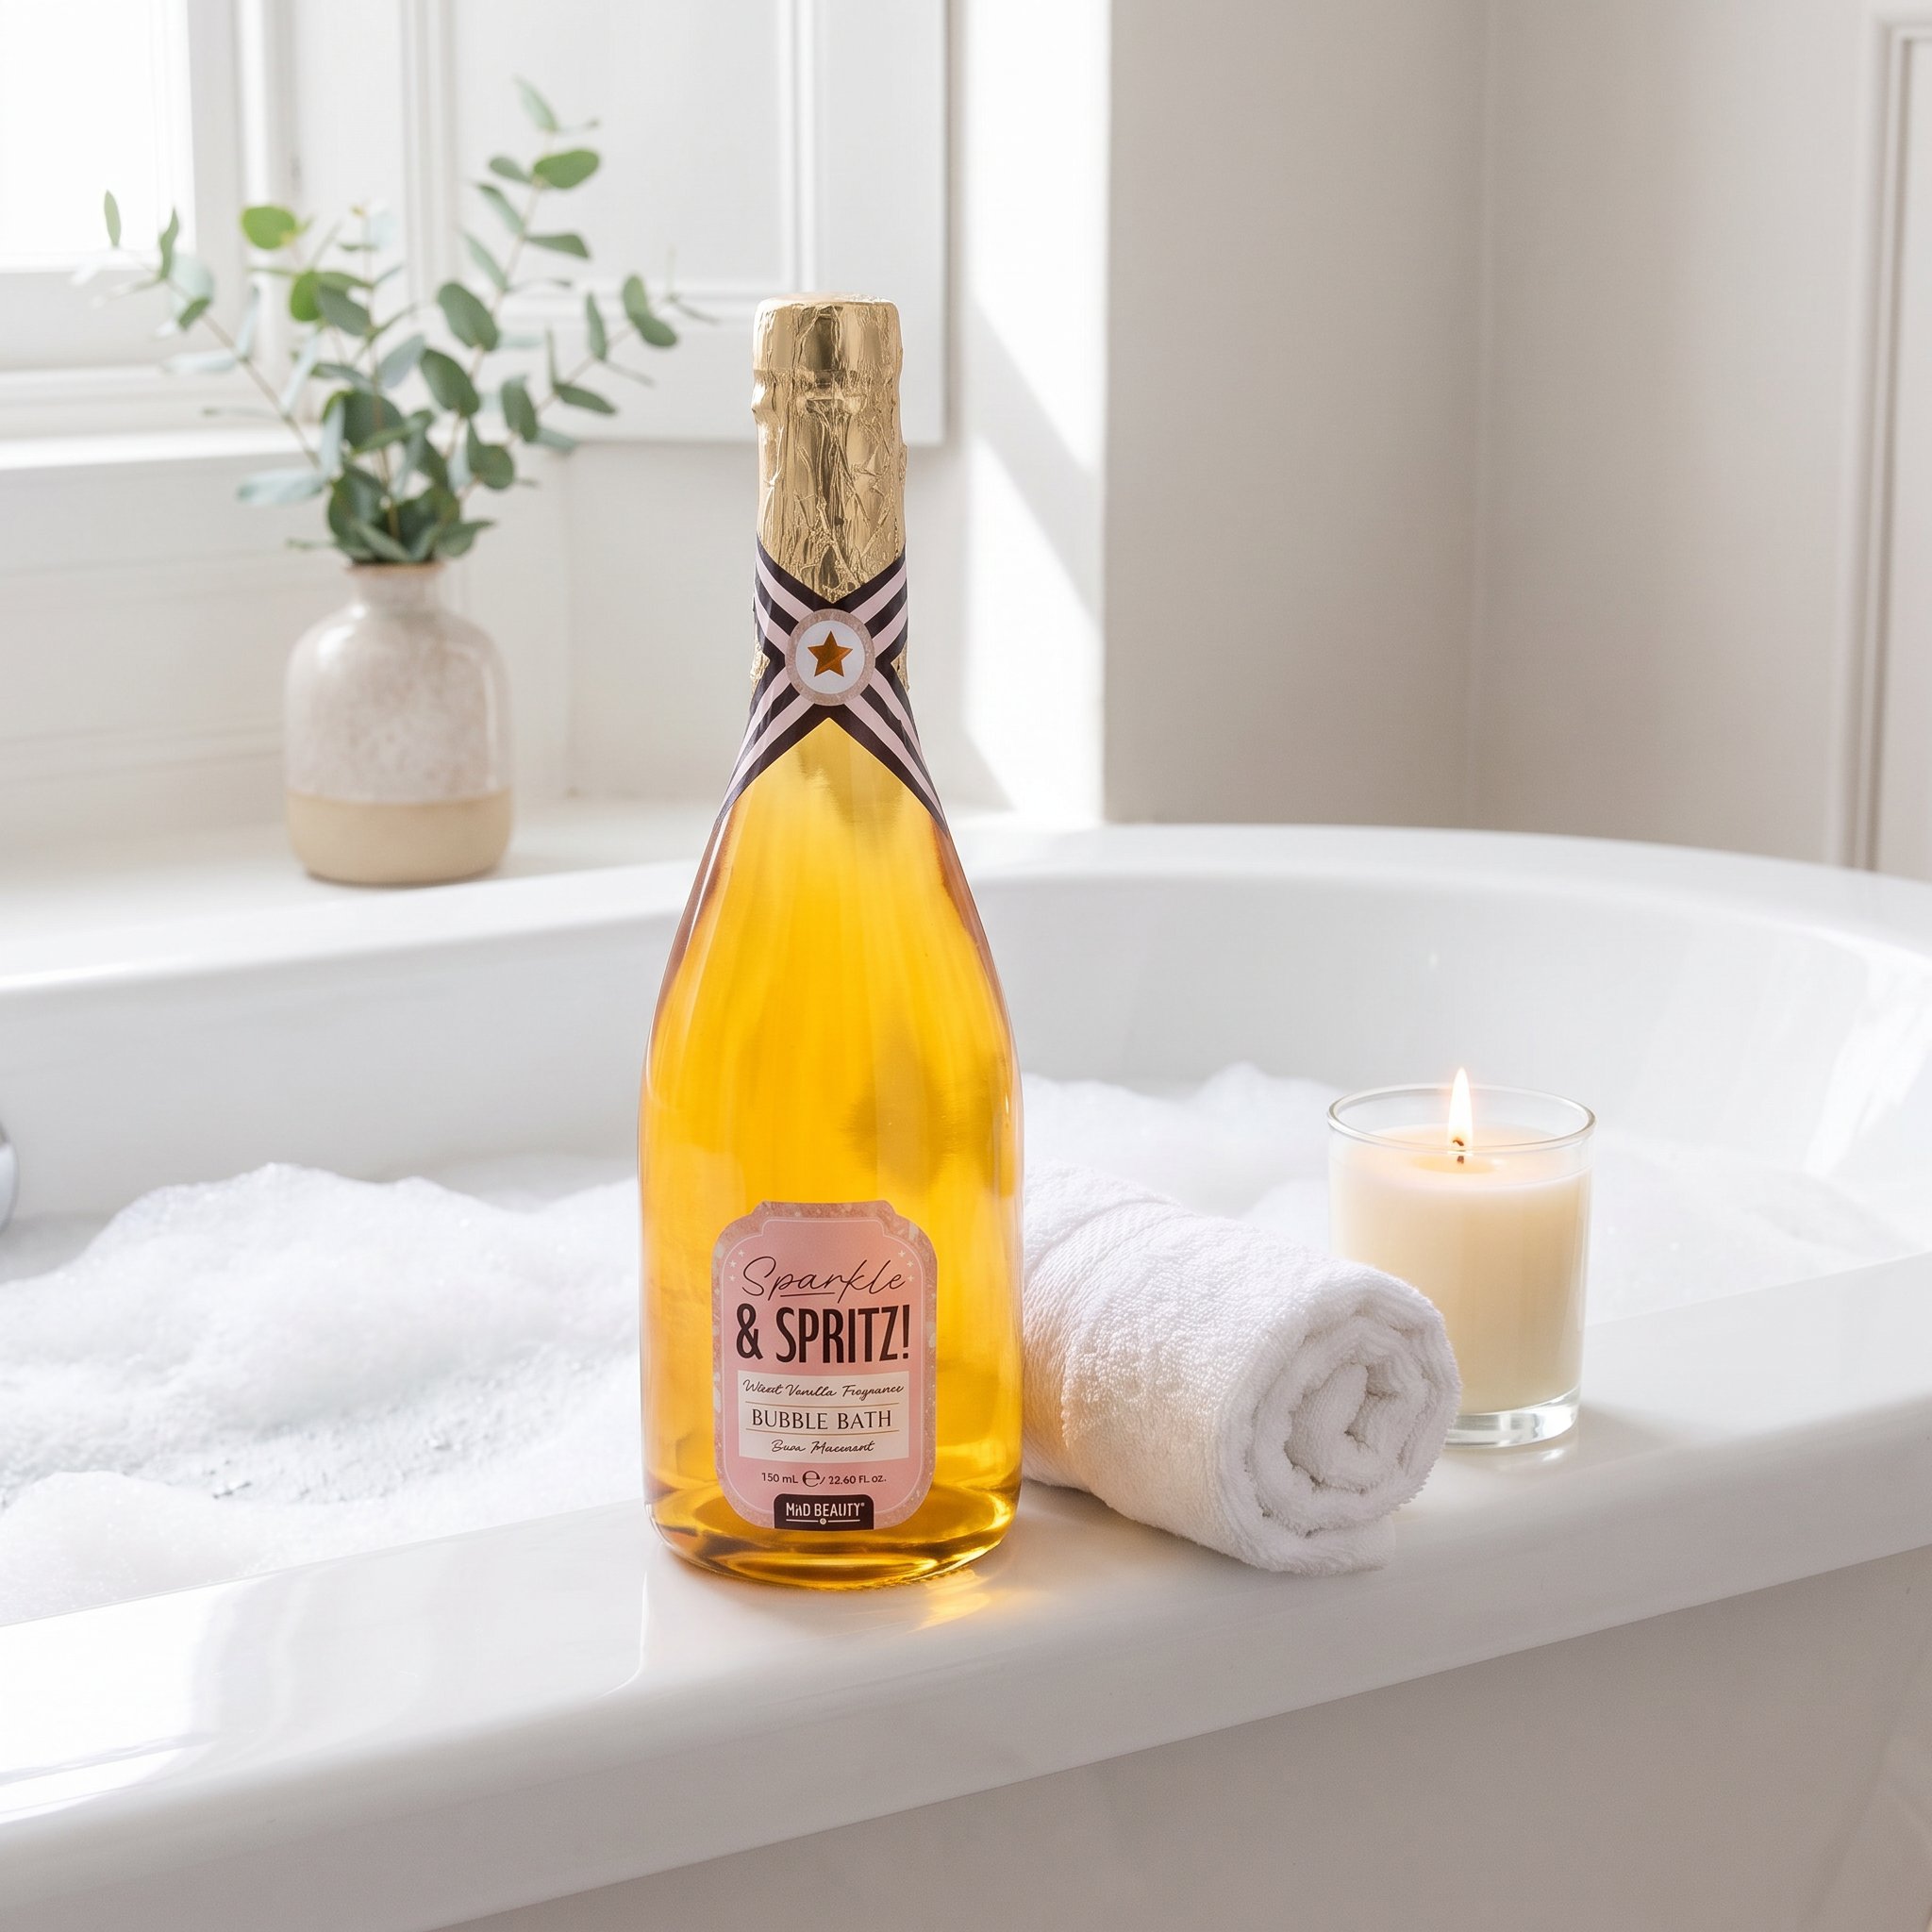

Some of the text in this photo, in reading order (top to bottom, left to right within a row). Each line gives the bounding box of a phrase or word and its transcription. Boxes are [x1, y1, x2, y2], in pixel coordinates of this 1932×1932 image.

[741, 1256, 906, 1304] Sparkle
[736, 1303, 910, 1364] & SPRITZ!
[752, 1408, 891, 1430] BUBBLE BATH
[761, 1472, 780, 1483] 150
[782, 1474, 799, 1484] mL
[828, 1475, 857, 1485] 22.60
